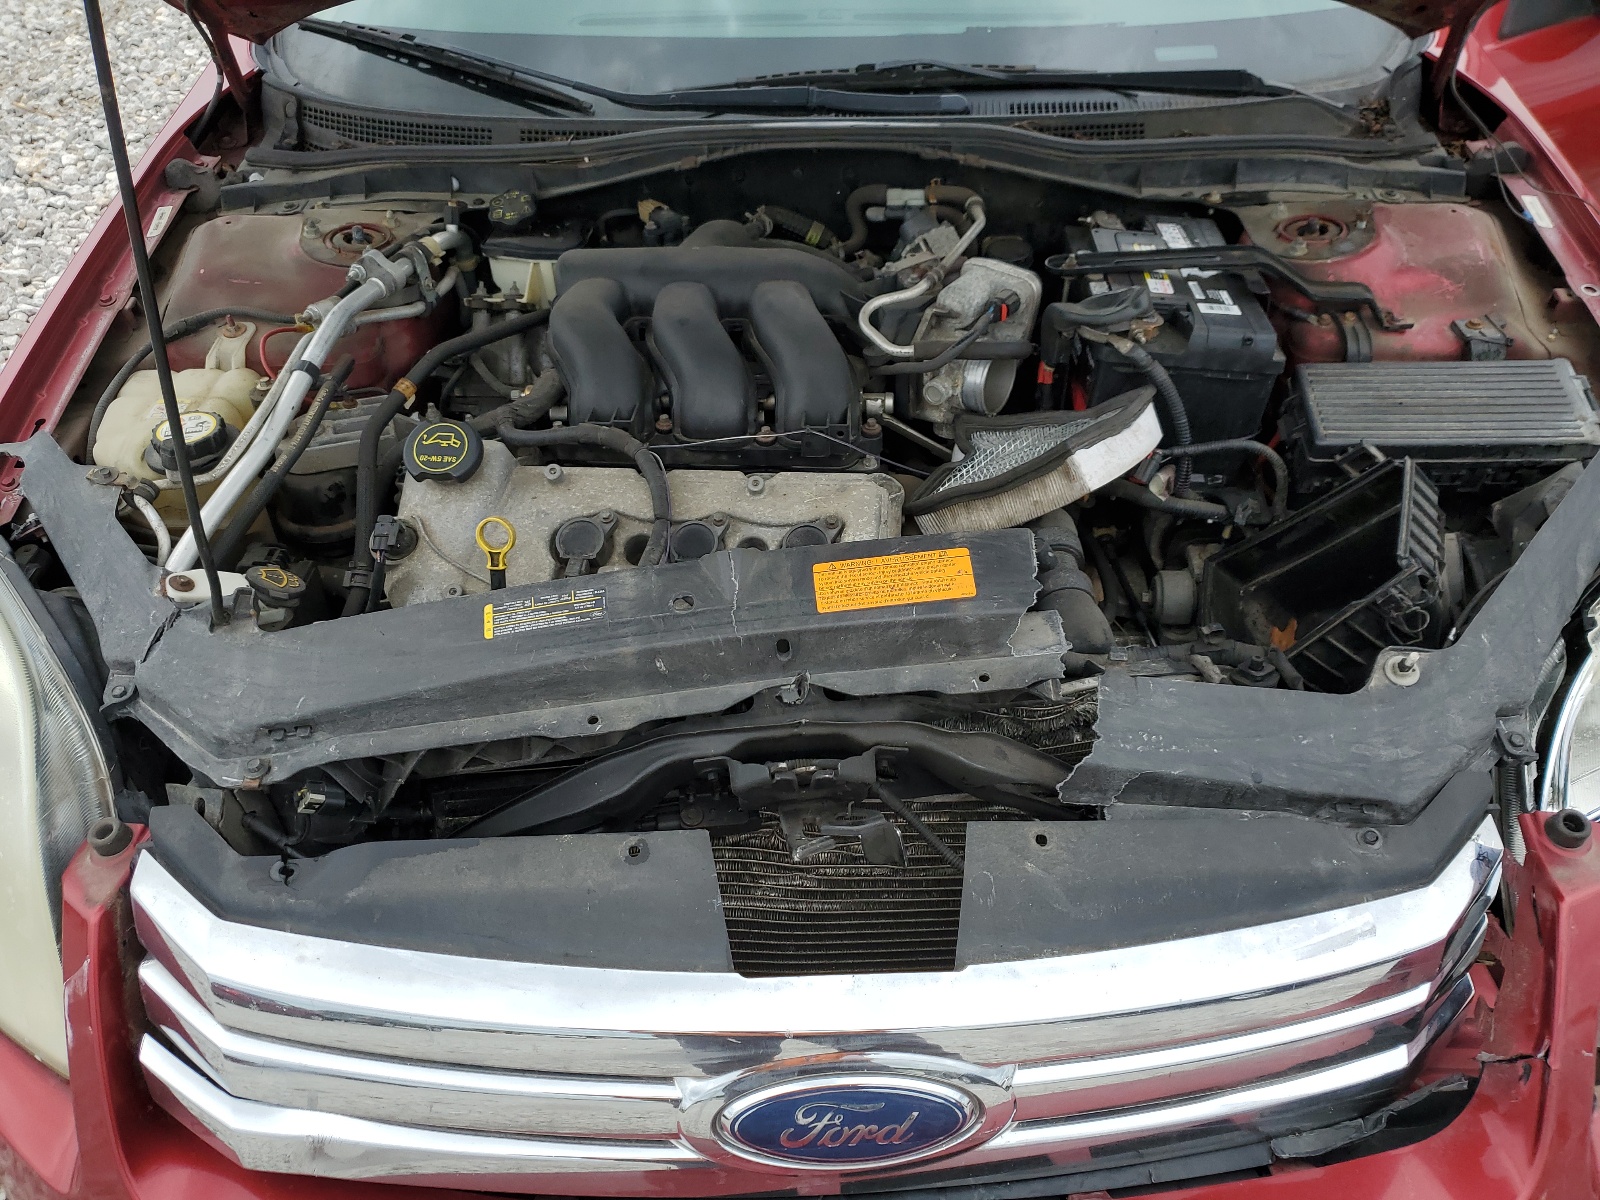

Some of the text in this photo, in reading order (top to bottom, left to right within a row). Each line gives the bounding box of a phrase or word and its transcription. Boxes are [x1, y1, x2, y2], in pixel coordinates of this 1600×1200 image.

[419, 454, 457, 463] SAE 5W-20
[780, 1101, 920, 1148] Ford
